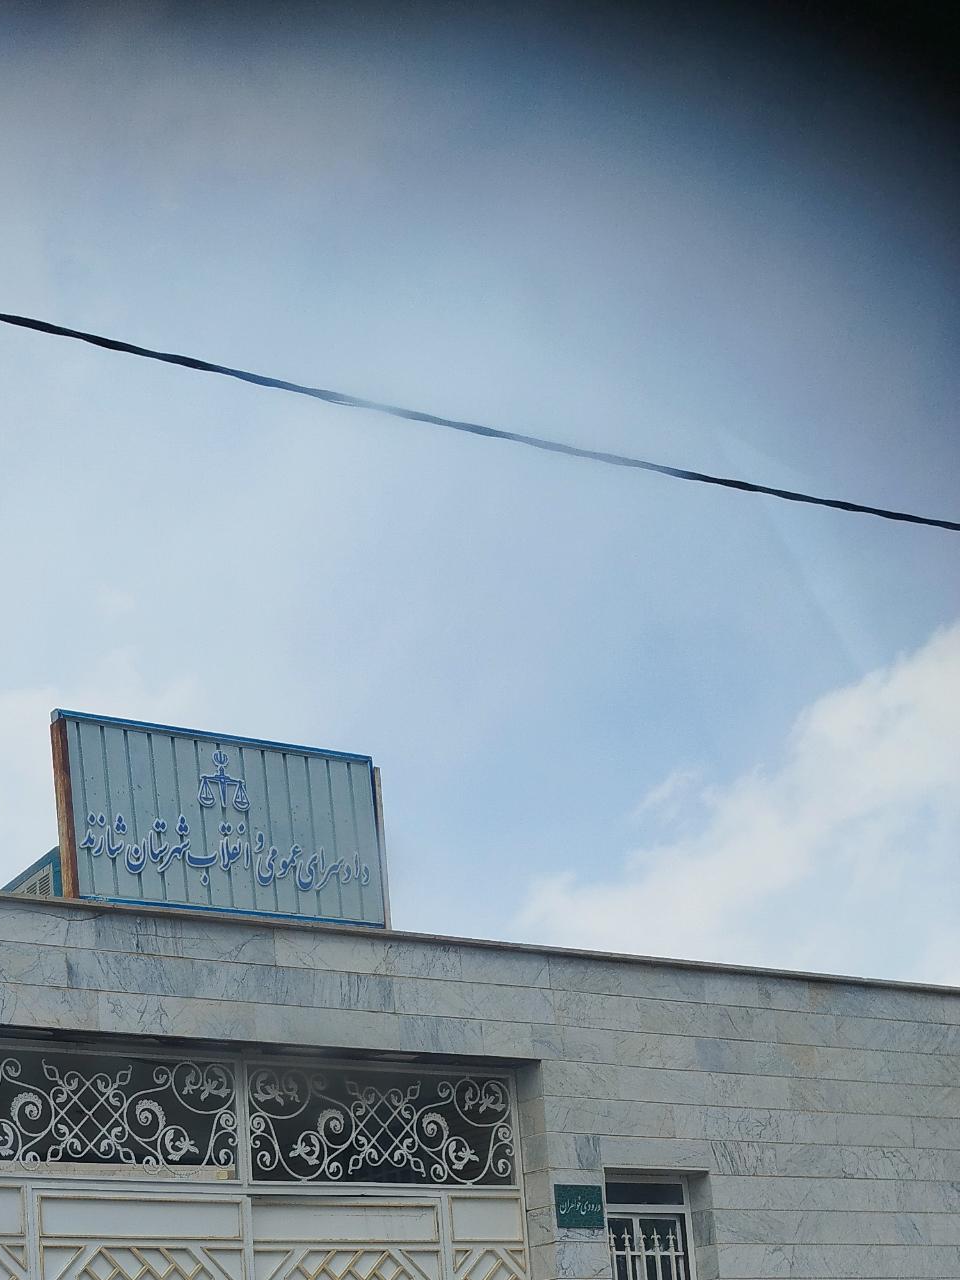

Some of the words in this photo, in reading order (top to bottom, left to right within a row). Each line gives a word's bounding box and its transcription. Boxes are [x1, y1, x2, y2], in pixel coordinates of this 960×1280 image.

[80, 811, 126, 858] شازند
[125, 814, 191, 873] شهرستان
[186, 821, 251, 886] انقلاب
[253, 831, 266, 853] و
[255, 844, 302, 886] عمومی
[296, 847, 370, 891] دادسرای
[559, 1195, 581, 1215] خواهران
[580, 1200, 601, 1215] ورودی
